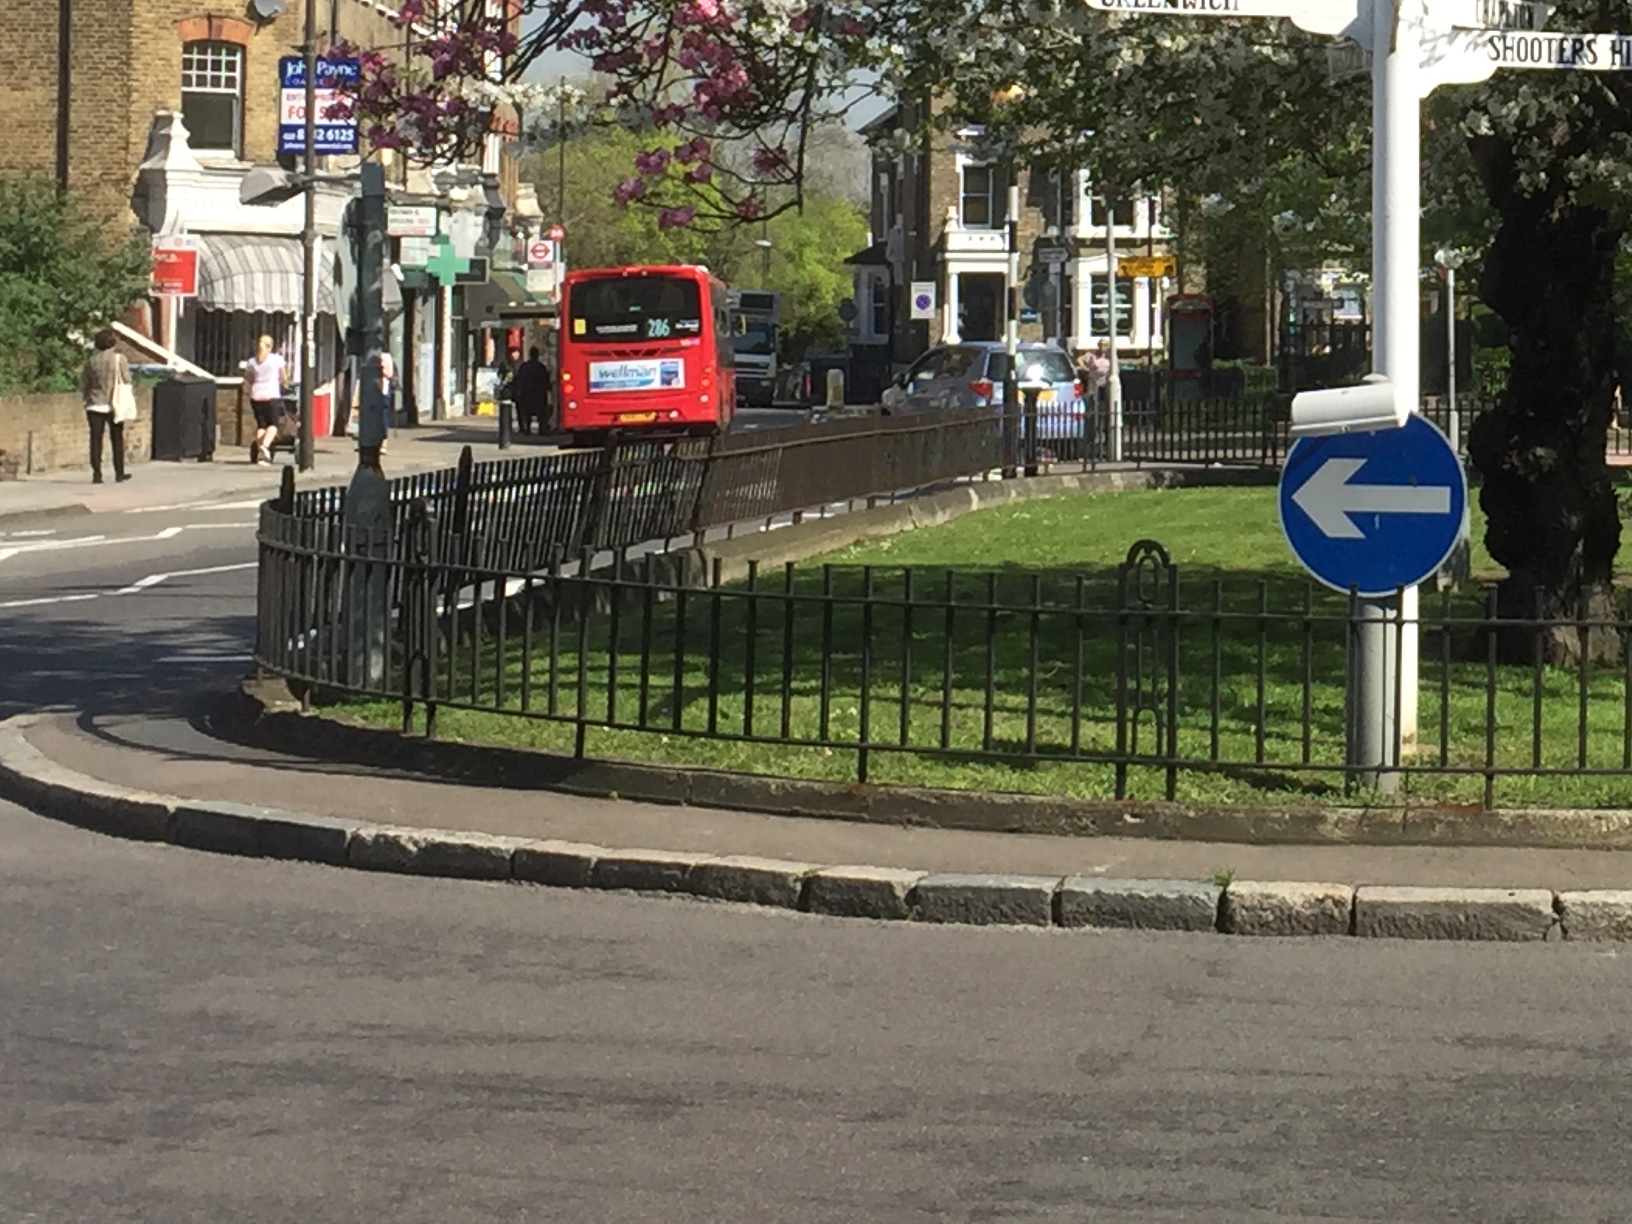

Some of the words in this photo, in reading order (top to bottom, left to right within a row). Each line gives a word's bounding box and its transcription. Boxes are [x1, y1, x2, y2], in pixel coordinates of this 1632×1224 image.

[1487, 33, 1599, 67] SHOOTERS
[316, 60, 359, 78] Payne
[648, 319, 670, 337] 286
